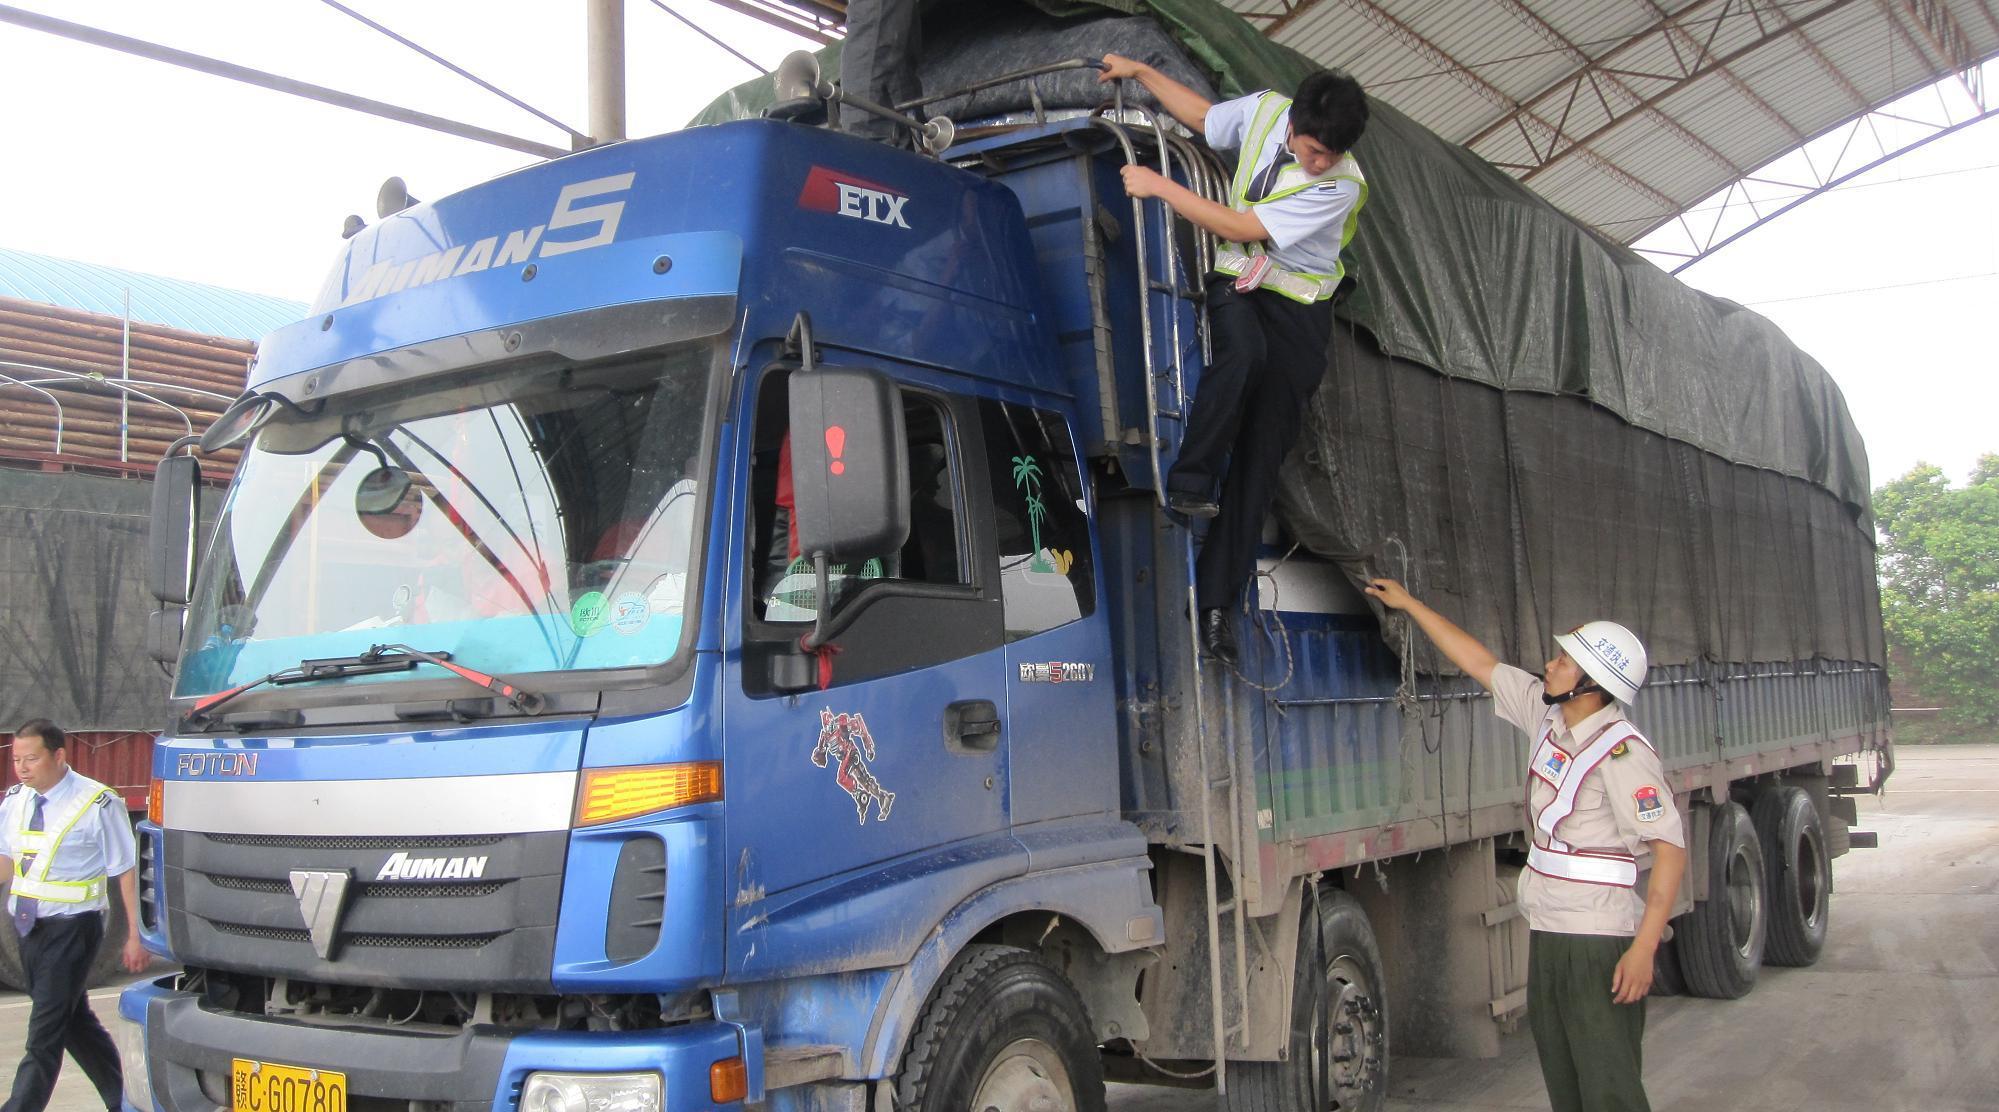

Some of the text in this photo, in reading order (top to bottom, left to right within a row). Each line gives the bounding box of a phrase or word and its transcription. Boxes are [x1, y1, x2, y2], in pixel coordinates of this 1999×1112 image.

[834, 182, 912, 229] ETX
[1594, 637, 1630, 671] 交通执法
[178, 752, 259, 776] FOTON
[375, 851, 488, 881] AUMAN
